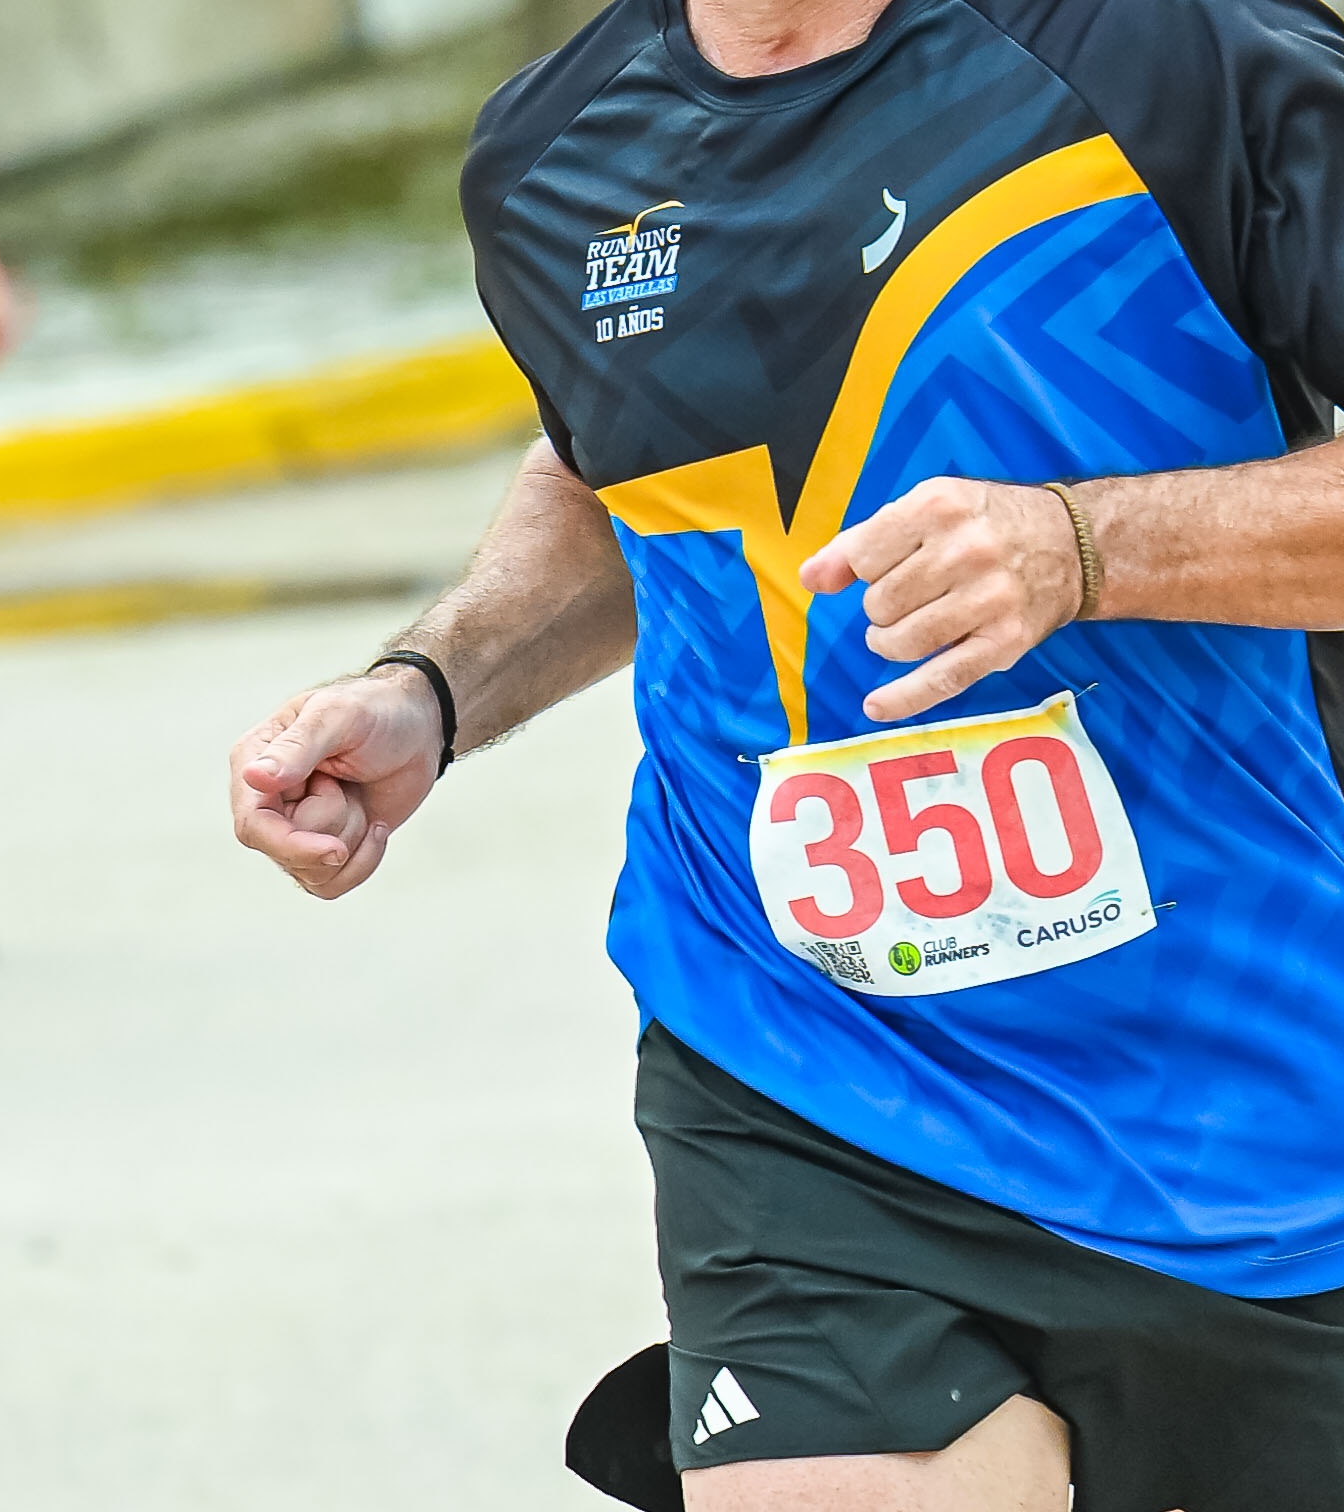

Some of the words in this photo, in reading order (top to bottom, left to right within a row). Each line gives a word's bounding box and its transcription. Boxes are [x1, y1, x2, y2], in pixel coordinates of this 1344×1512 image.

[586, 224, 681, 260] RUNNING
[586, 244, 680, 291] TEAM
[584, 290, 607, 308] LAS
[596, 317, 614, 343] 10
[617, 304, 664, 338] AÑOS
[769, 736, 1104, 939] 350
[1017, 903, 1121, 948] CARUSO
[923, 936, 958, 954] CLUB
[925, 943, 990, 967] RUNNER'S
